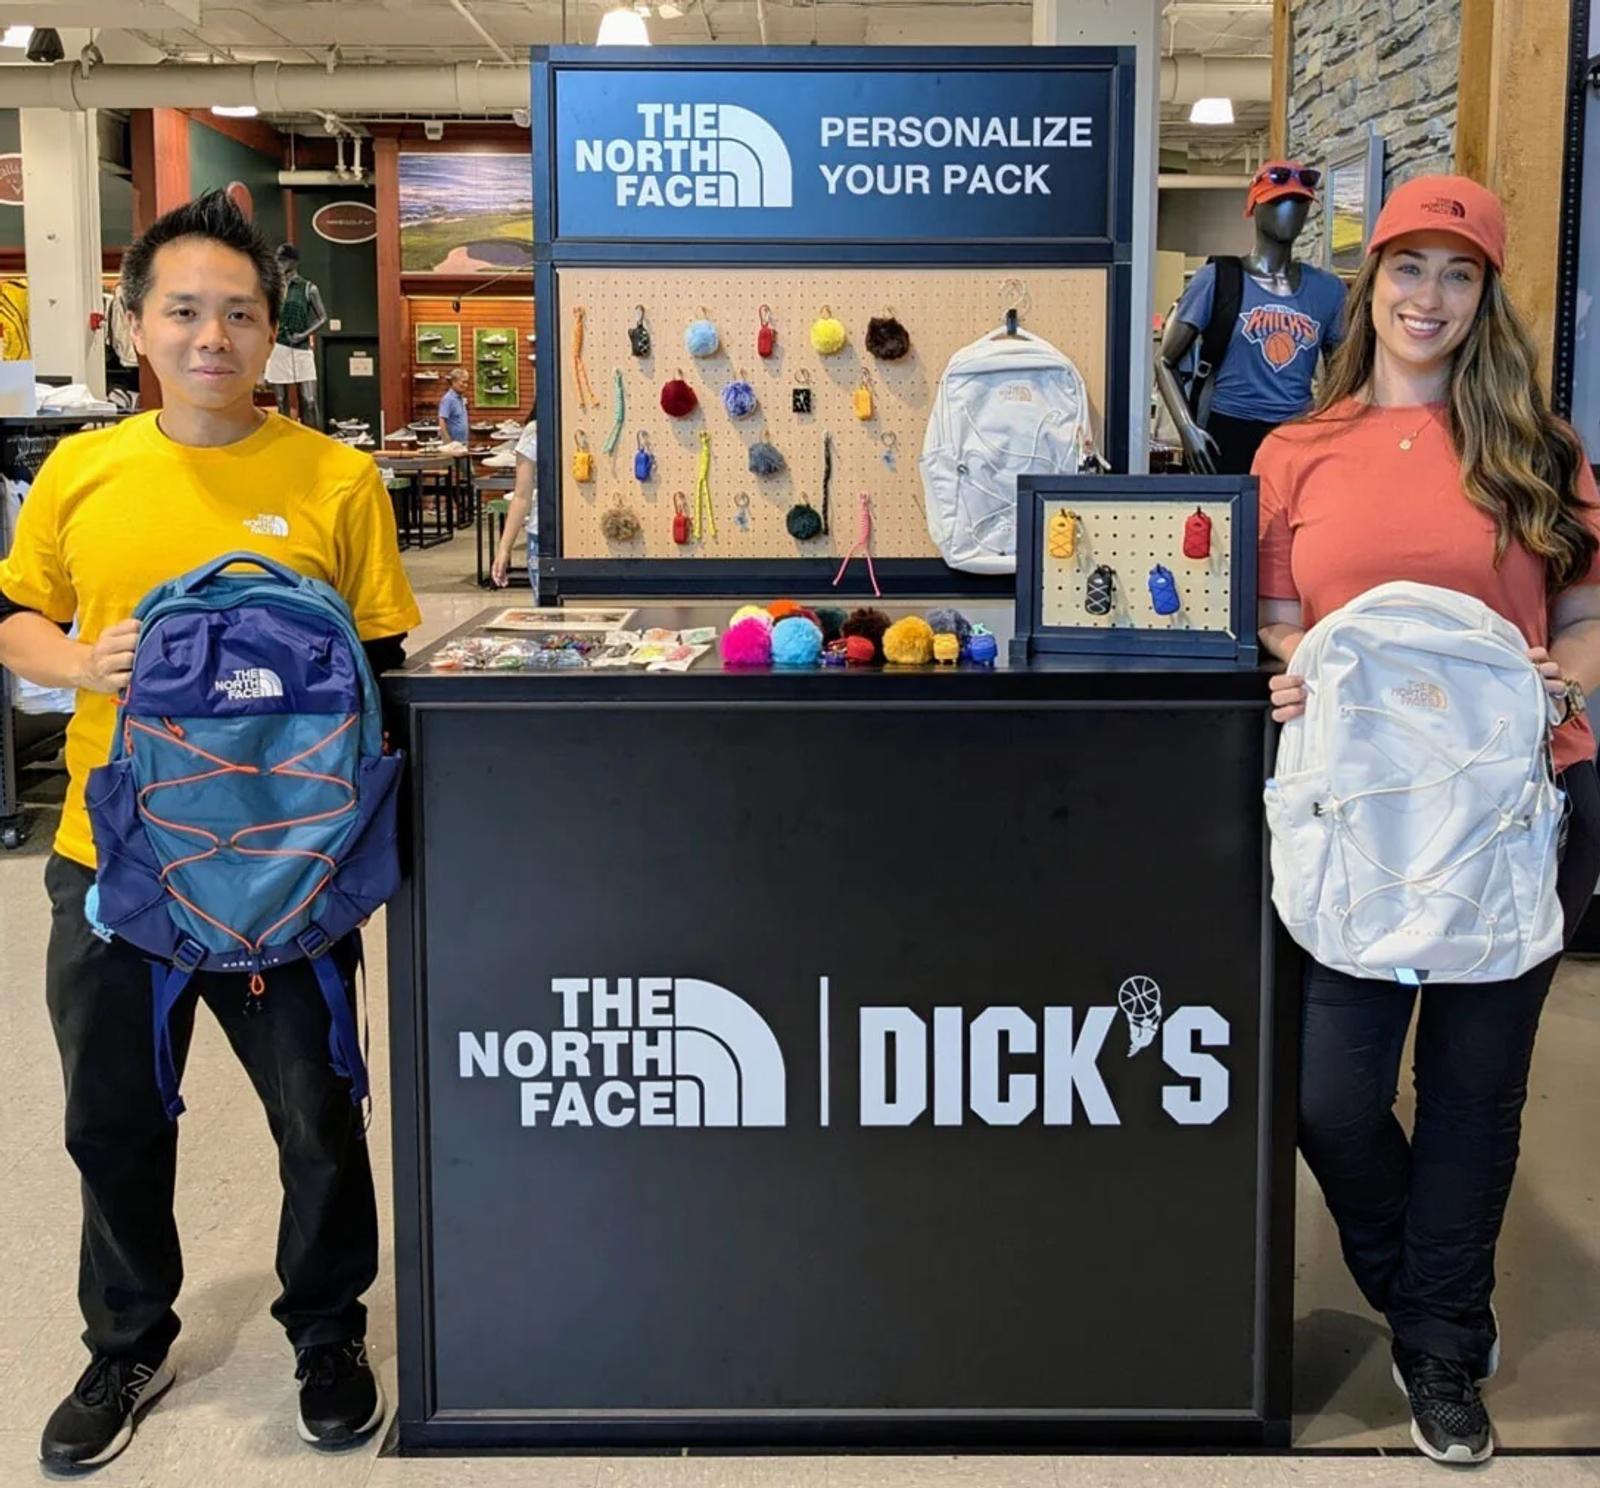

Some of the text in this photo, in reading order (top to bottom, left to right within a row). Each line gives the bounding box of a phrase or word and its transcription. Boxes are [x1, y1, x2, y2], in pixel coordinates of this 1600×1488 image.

[637, 103, 718, 138] THE
[820, 116, 1093, 148] PERSONALIZE
[575, 139, 718, 172] NORTH
[616, 174, 718, 207] FACE
[819, 164, 1051, 195] YOUR PACK
[1245, 308, 1316, 342] KNICKS
[242, 519, 274, 530] NORTH
[214, 678, 260, 691] NORTH
[232, 668, 260, 682] THE
[228, 688, 260, 700] FACE
[551, 977, 673, 1028] THE
[459, 1030, 673, 1078] NORTH
[860, 975, 1230, 1126] DICK'S
[521, 1080, 674, 1127] FACE
